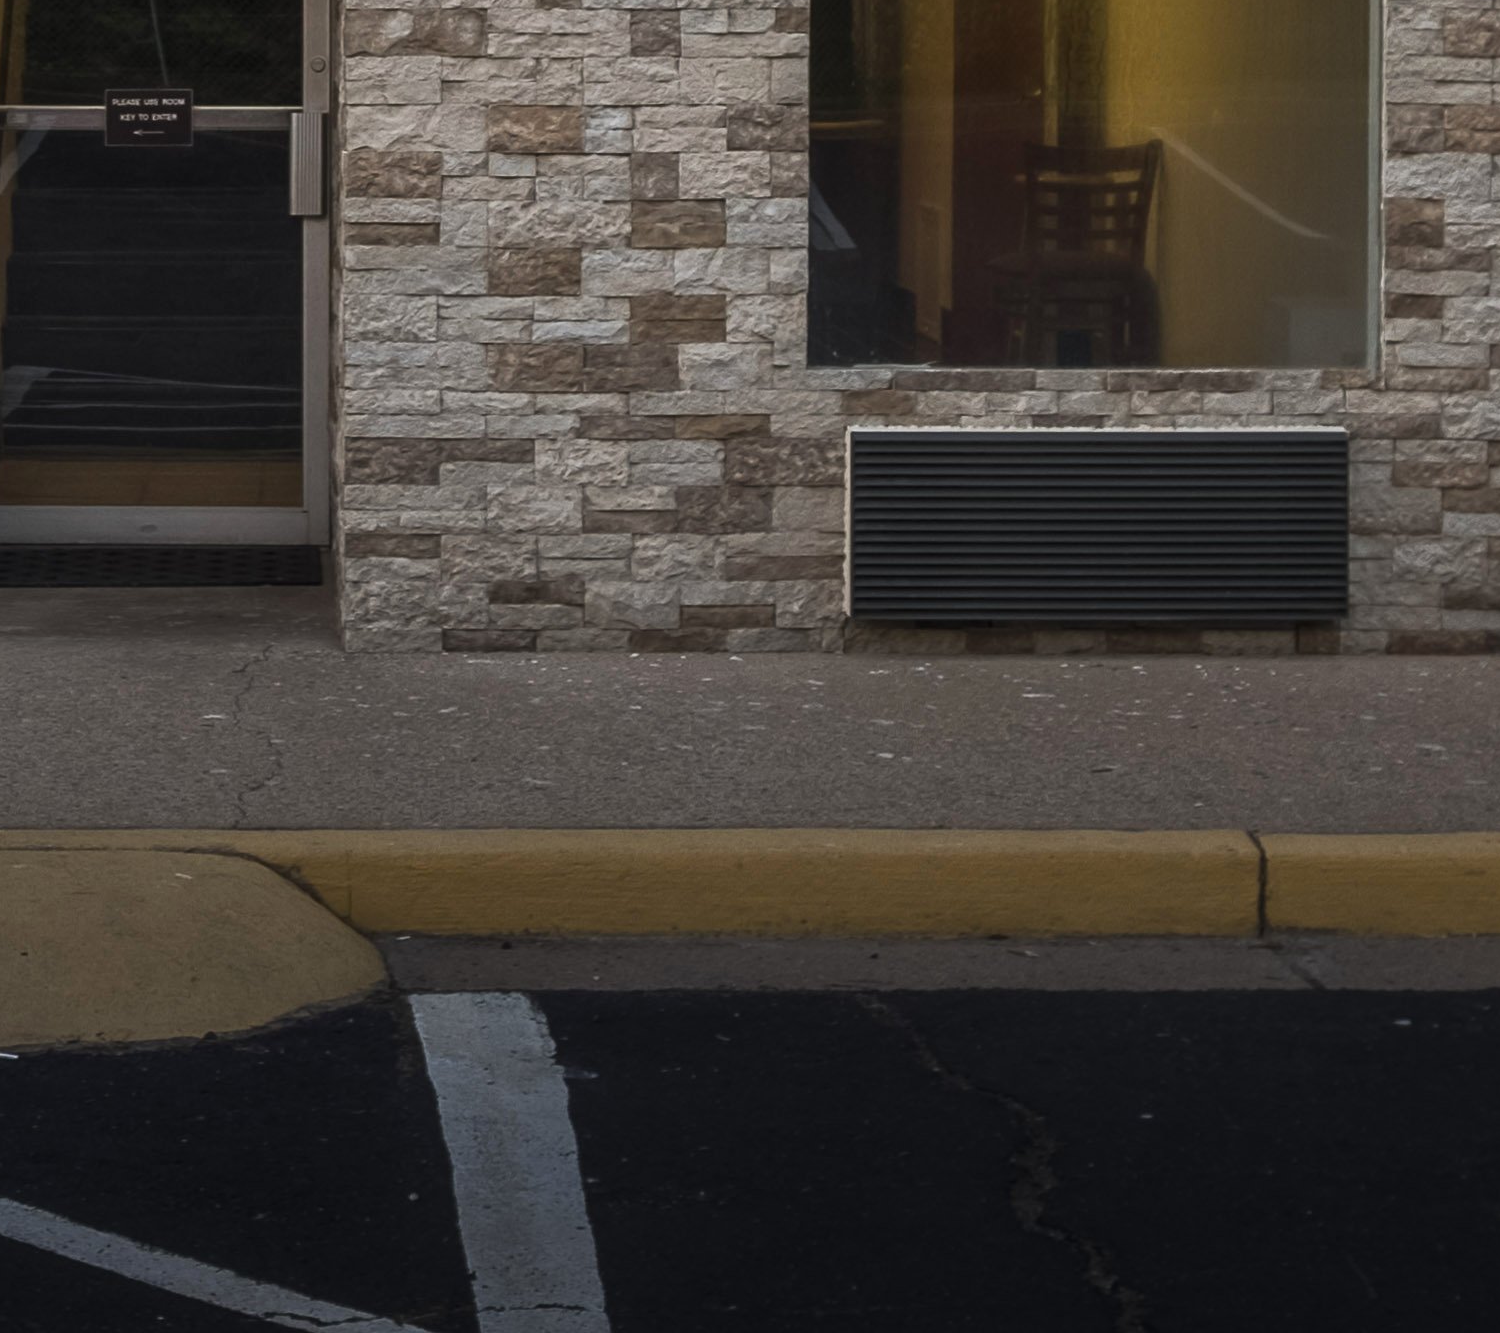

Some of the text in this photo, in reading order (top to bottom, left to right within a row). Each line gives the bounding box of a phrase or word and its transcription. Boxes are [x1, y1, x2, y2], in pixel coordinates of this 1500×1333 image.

[111, 98, 141, 106] PLEASE
[120, 113, 178, 121] KEY TO ENTER
